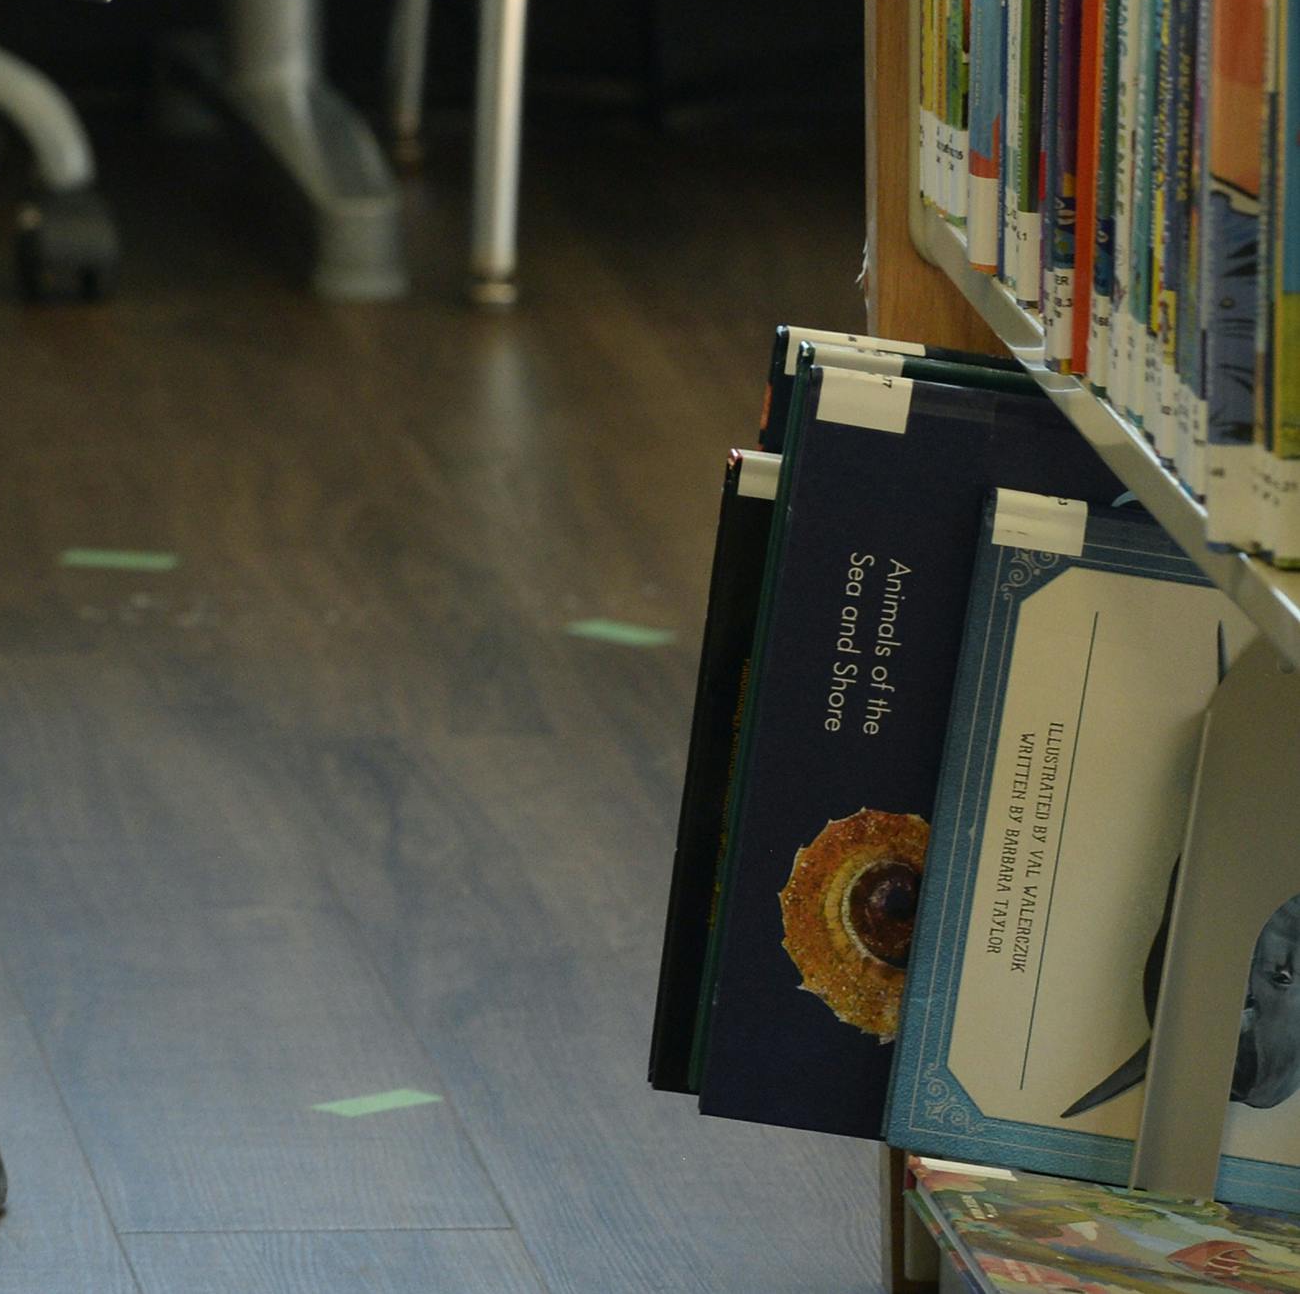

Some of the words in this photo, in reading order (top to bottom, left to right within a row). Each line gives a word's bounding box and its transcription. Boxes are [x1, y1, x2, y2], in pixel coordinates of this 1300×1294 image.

[845, 551, 875, 597] Sea
[836, 606, 862, 654] and
[874, 558, 913, 657] Animals
[824, 661, 858, 733] Shore
[870, 665, 896, 693] of
[862, 698, 892, 736] the
[1012, 732, 1036, 801] WRITTEN
[1035, 722, 1065, 821] ILLUSTRATED
[1008, 805, 1025, 824] BY
[1031, 825, 1048, 844] BY
[996, 828, 1021, 893] BARBARA
[1025, 849, 1044, 878] VAL
[987, 899, 1009, 955] TAYLOR
[1010, 884, 1038, 974] WALERCZUK
